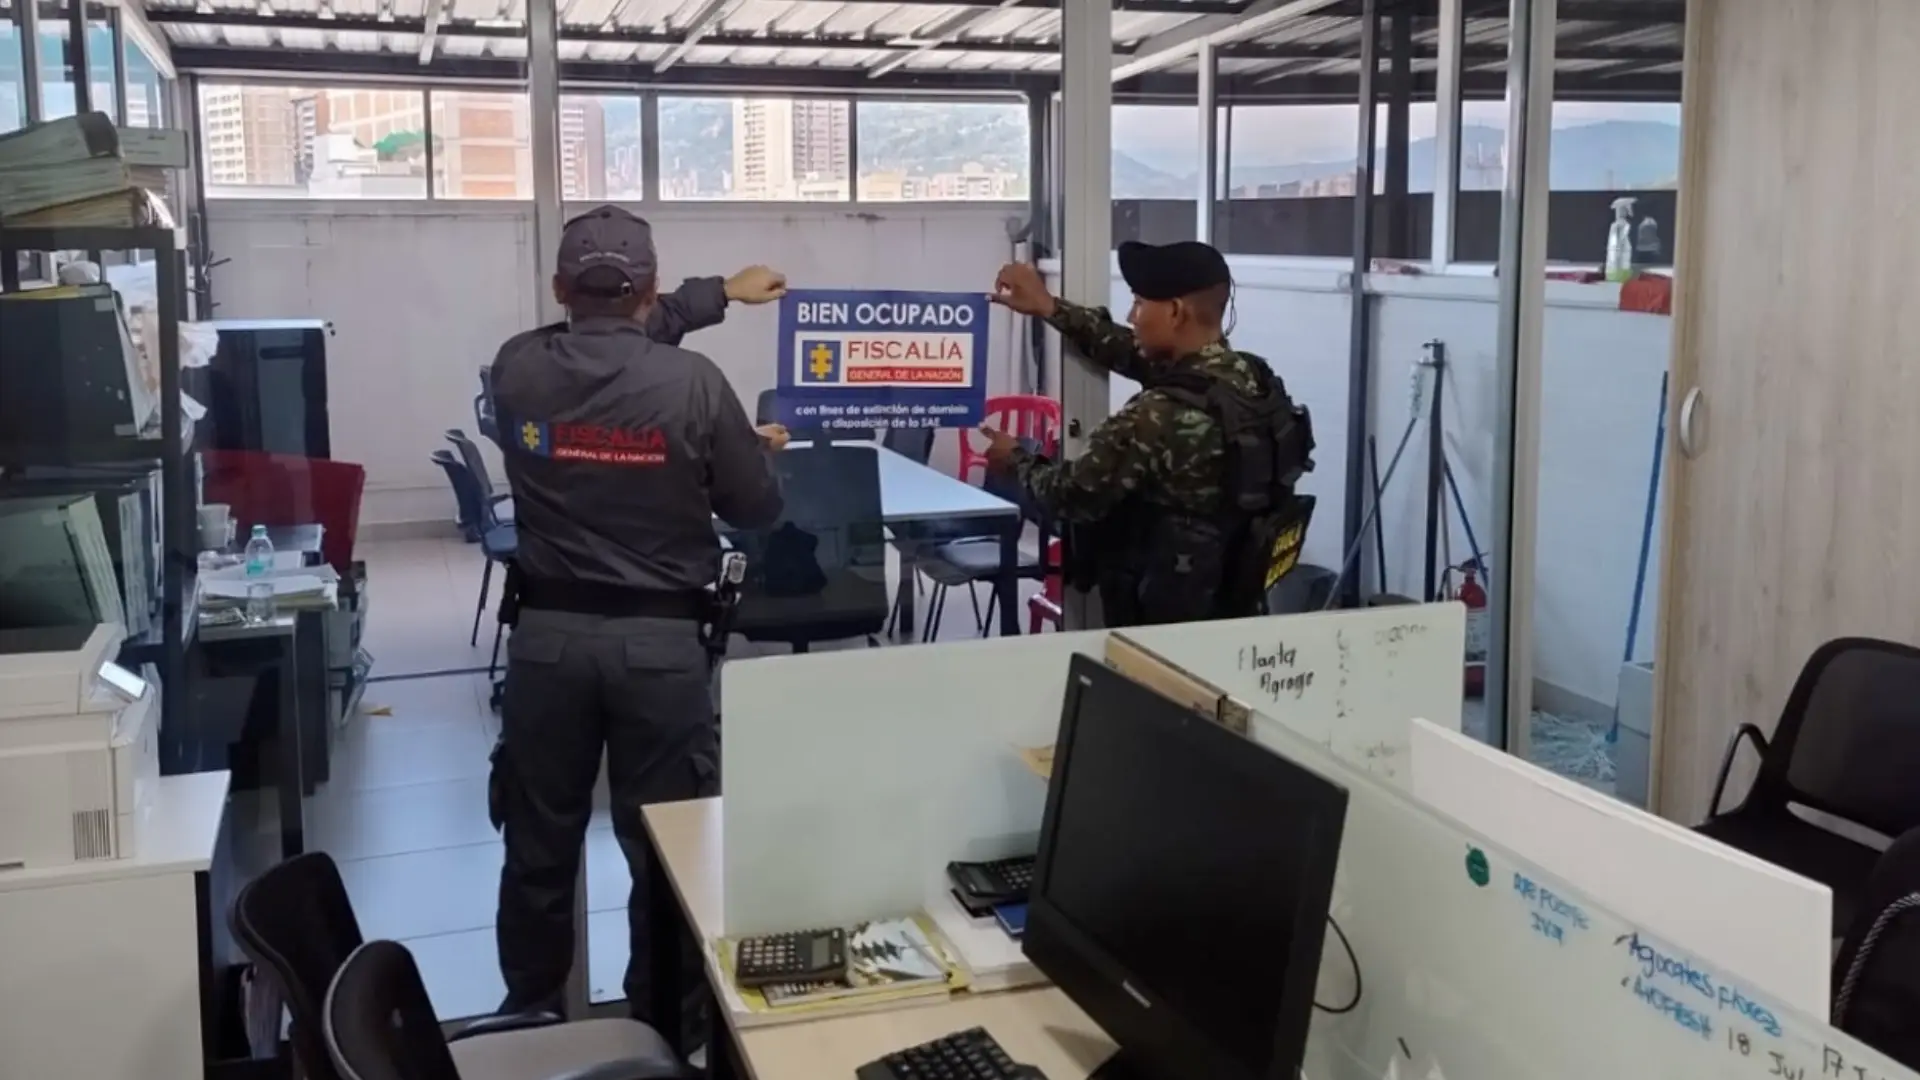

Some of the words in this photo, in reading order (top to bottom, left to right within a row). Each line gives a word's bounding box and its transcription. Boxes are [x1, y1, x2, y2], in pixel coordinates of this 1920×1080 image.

[797, 302, 848, 324] BIEN
[855, 303, 974, 325] OCUPADO
[847, 337, 963, 360] FISCALÍA
[850, 370, 893, 380] GENERAL
[895, 370, 908, 380] DE
[795, 406, 817, 416] con
[819, 404, 844, 416] fines
[846, 404, 860, 415] de
[911, 404, 925, 415] de
[891, 417, 906, 429] de
[555, 447, 597, 460] GENERAL
[599, 452, 611, 461] DE
[1729, 1027, 1750, 1056] 18
